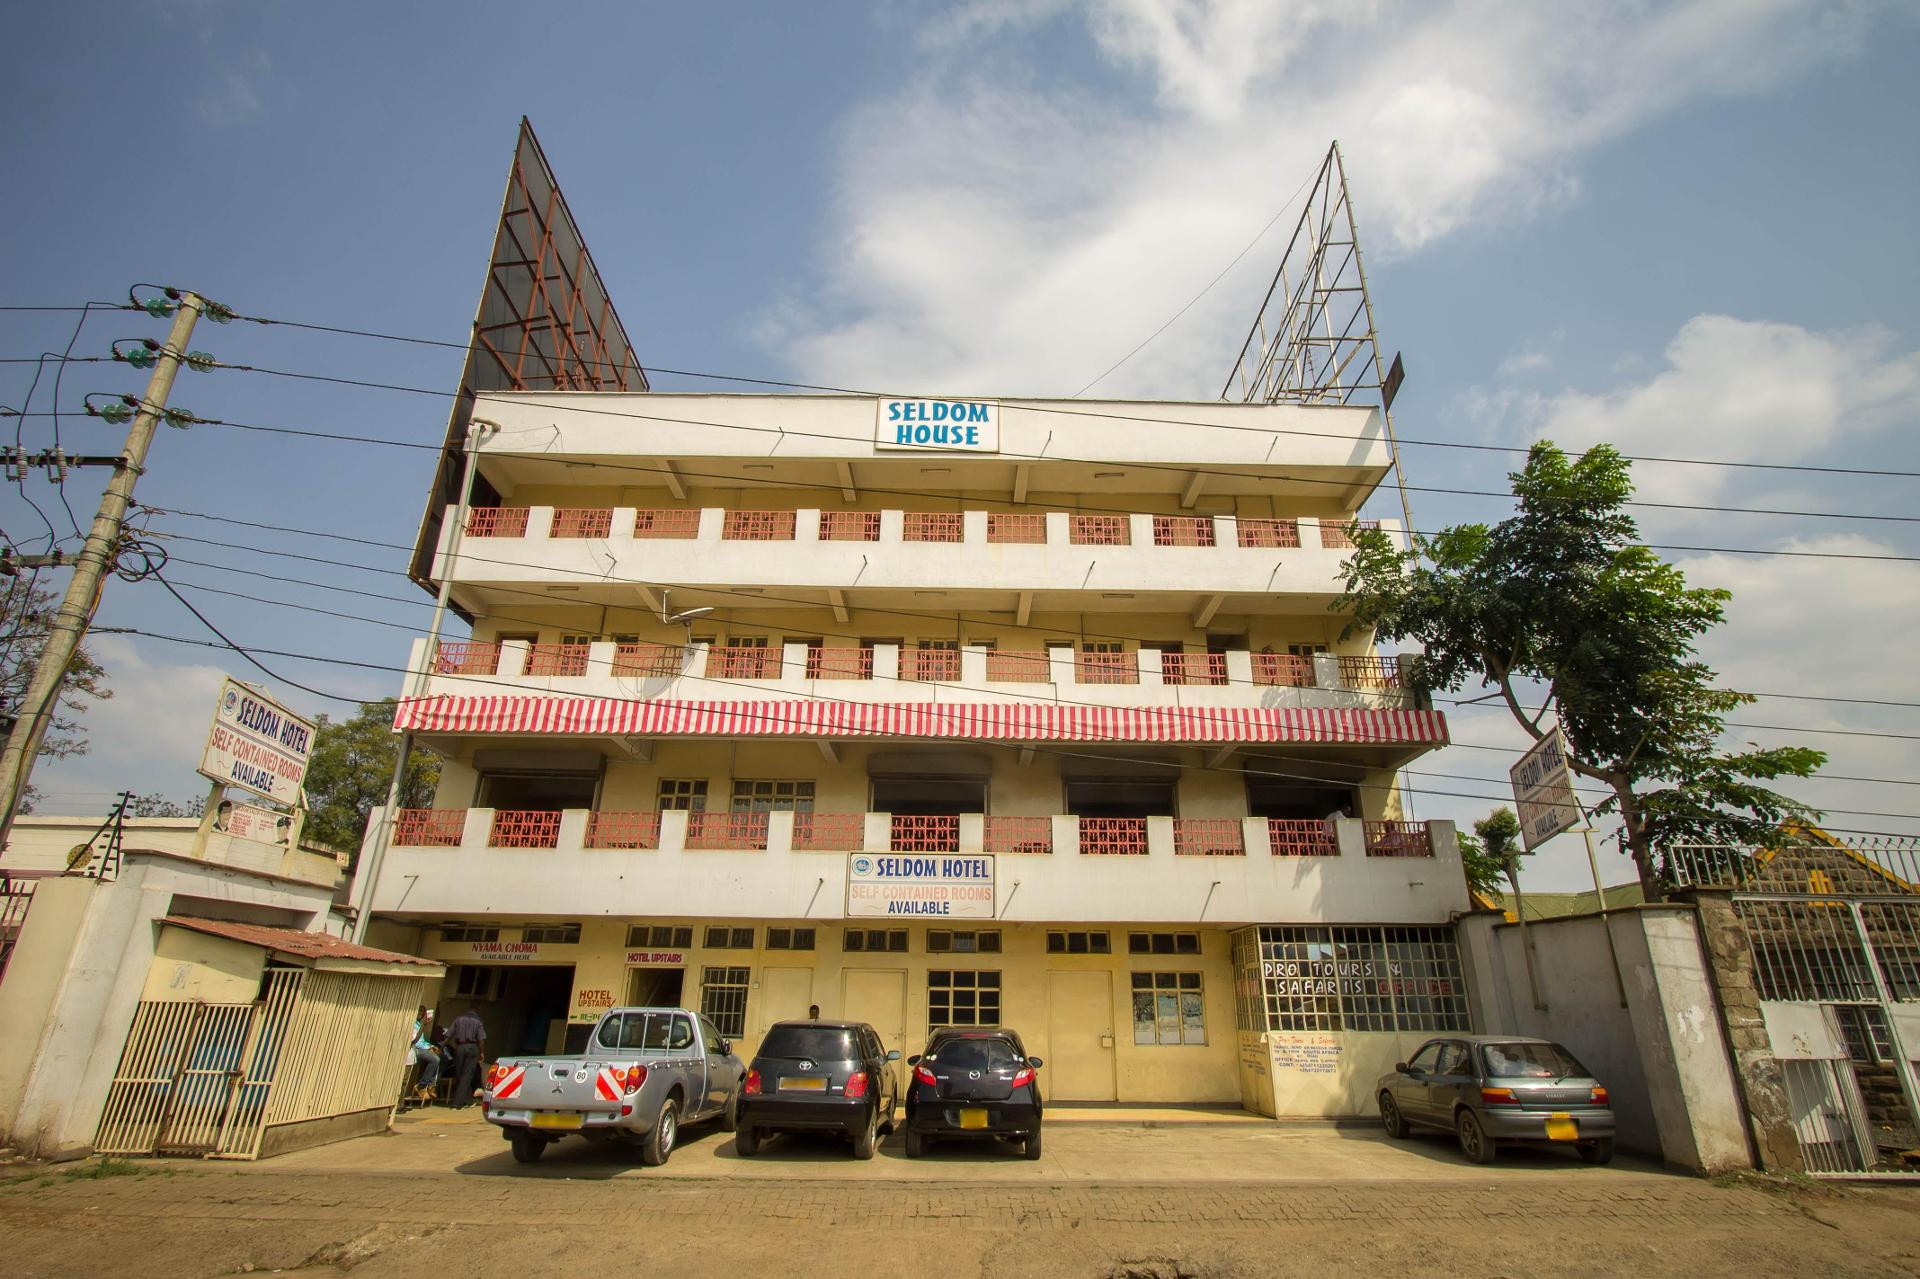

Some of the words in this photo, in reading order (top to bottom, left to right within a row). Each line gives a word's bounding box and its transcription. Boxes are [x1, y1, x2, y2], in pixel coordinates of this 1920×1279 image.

[888, 402, 989, 423] SELDOM
[896, 424, 979, 445] HOUSE
[236, 697, 281, 740] SELDOM
[279, 719, 309, 755] HOTEL
[212, 727, 234, 753] SELF
[232, 737, 279, 772] CONTAINED
[277, 758, 302, 784] ROOMS
[1539, 739, 1563, 776] HOTEL
[231, 760, 275, 793] AVAILABLE
[877, 857, 937, 878] SELDOM
[942, 859, 989, 878] HOTEL
[851, 885, 880, 899] SELF
[882, 885, 948, 901] CONTAINED
[951, 886, 992, 901] ROOMS
[888, 900, 950, 915] AVAILABLE
[472, 942, 502, 953] NYAMA
[504, 942, 538, 953] CHOMA
[480, 953, 512, 961] AVAILABLE
[627, 952, 650, 963] HOTEL
[651, 952, 683, 963] UPSTAIRS
[1264, 962, 1298, 977] PRO
[1312, 962, 1372, 977] TOURS
[579, 990, 612, 1000] HOTEL
[1278, 979, 1362, 995] SAFARIS
[1378, 979, 1451, 995] OFFICE
[577, 1000, 613, 1008] UPSTAIRS
[576, 1071, 587, 1080] 80
